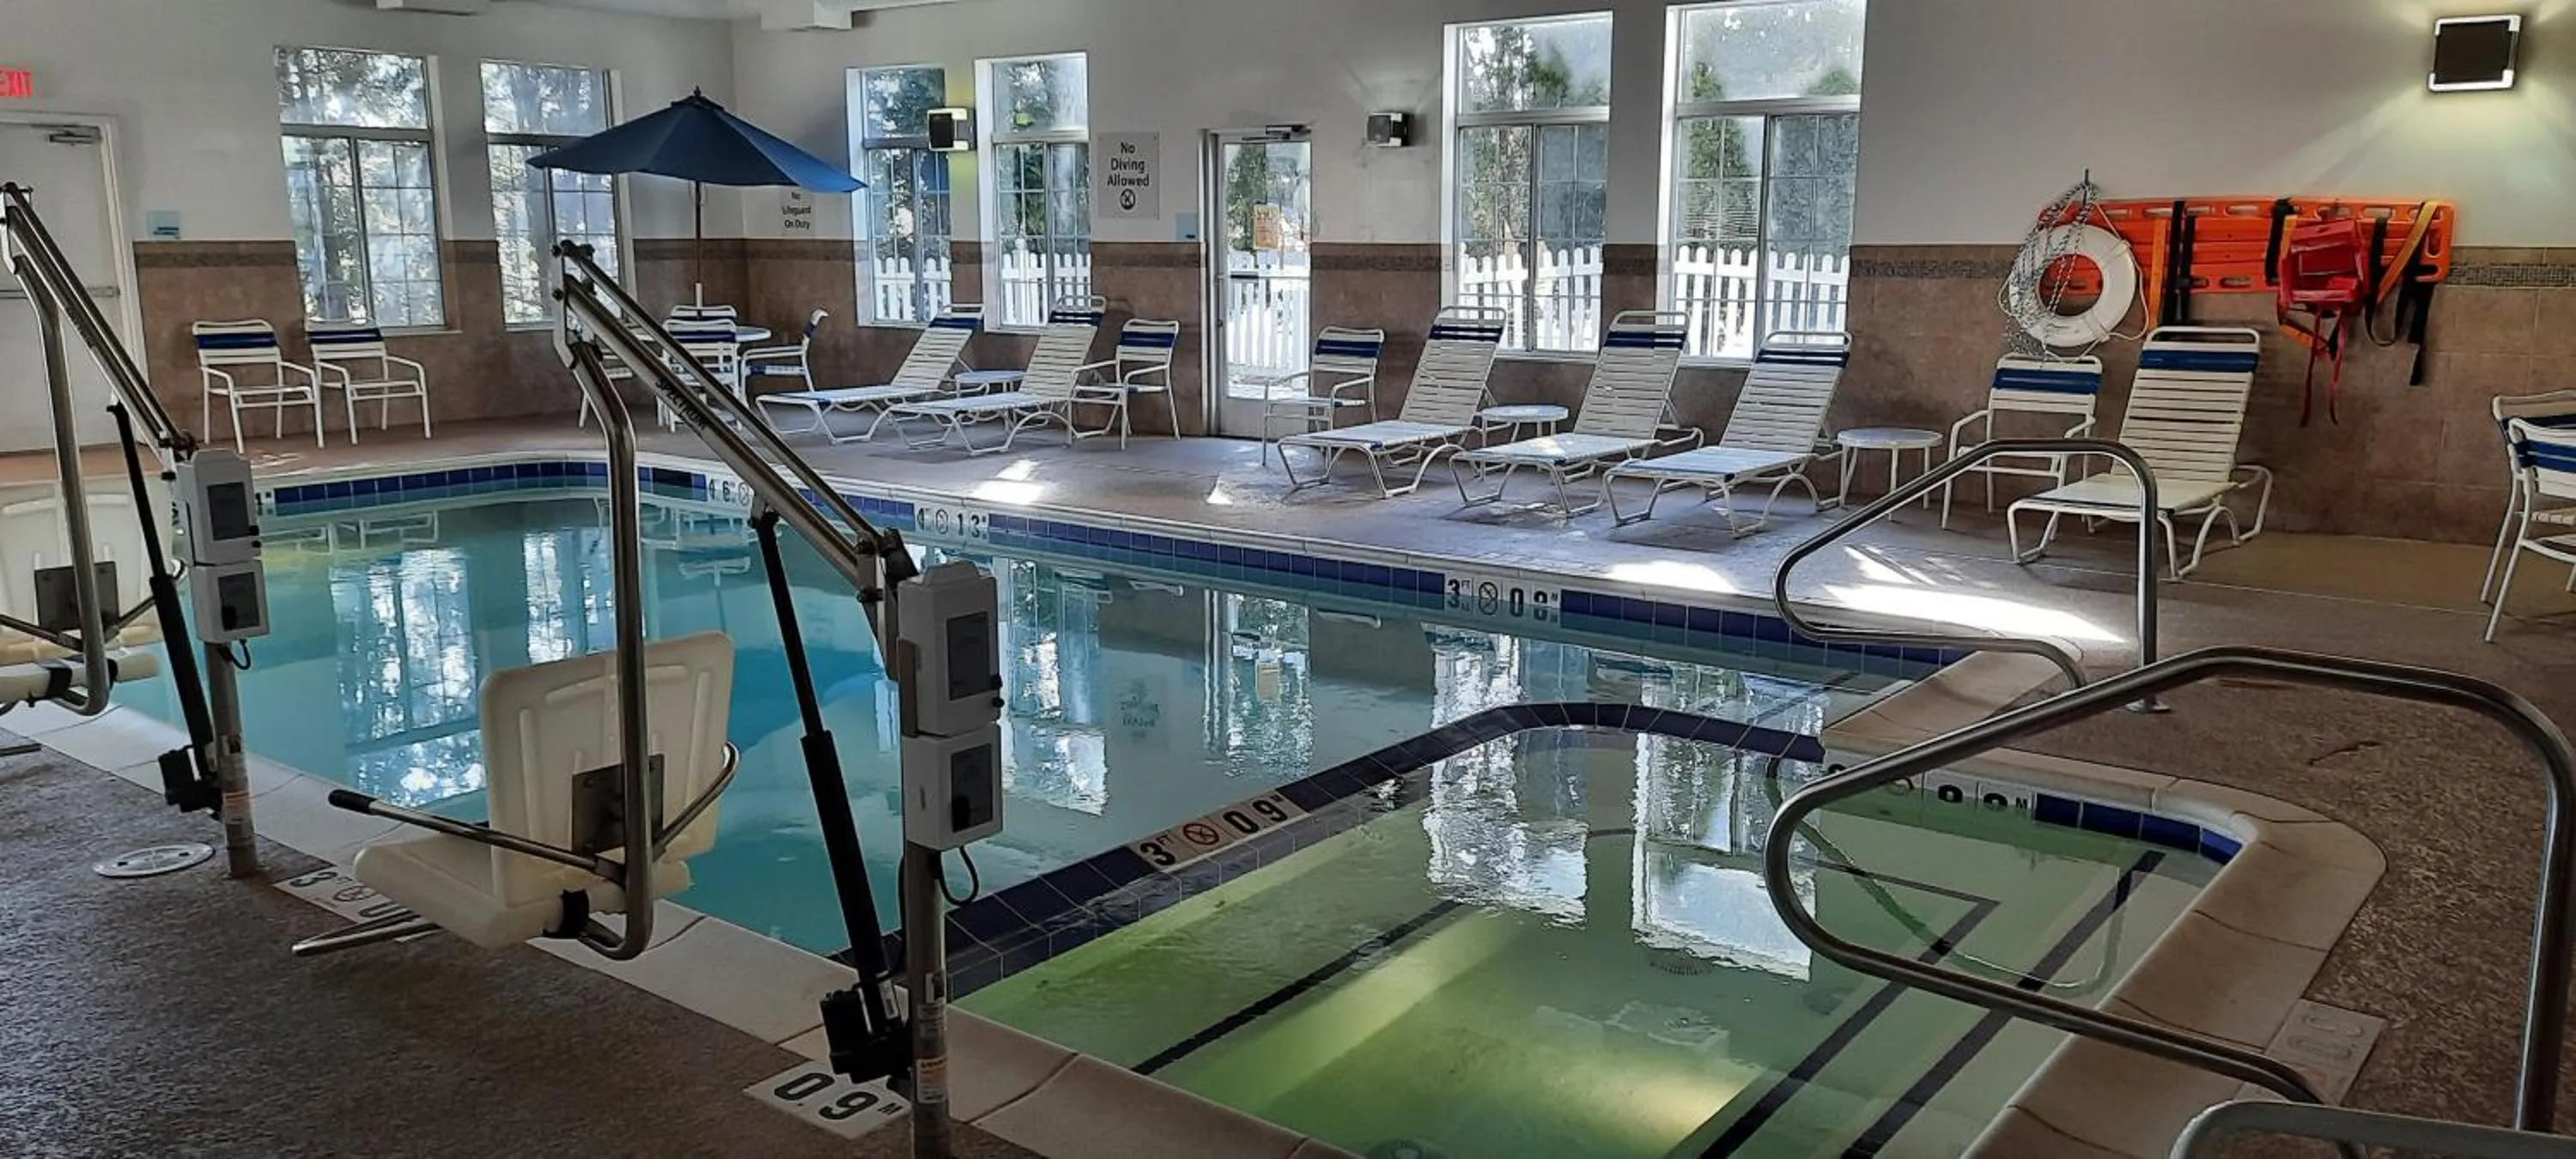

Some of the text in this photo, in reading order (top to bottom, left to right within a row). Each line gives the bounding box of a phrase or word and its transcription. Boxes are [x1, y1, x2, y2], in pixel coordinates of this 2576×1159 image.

[1121, 142, 1135, 155] No
[1111, 158, 1145, 174] Diving
[1108, 174, 1150, 186] Allowed
[1140, 842, 1176, 865] 3
